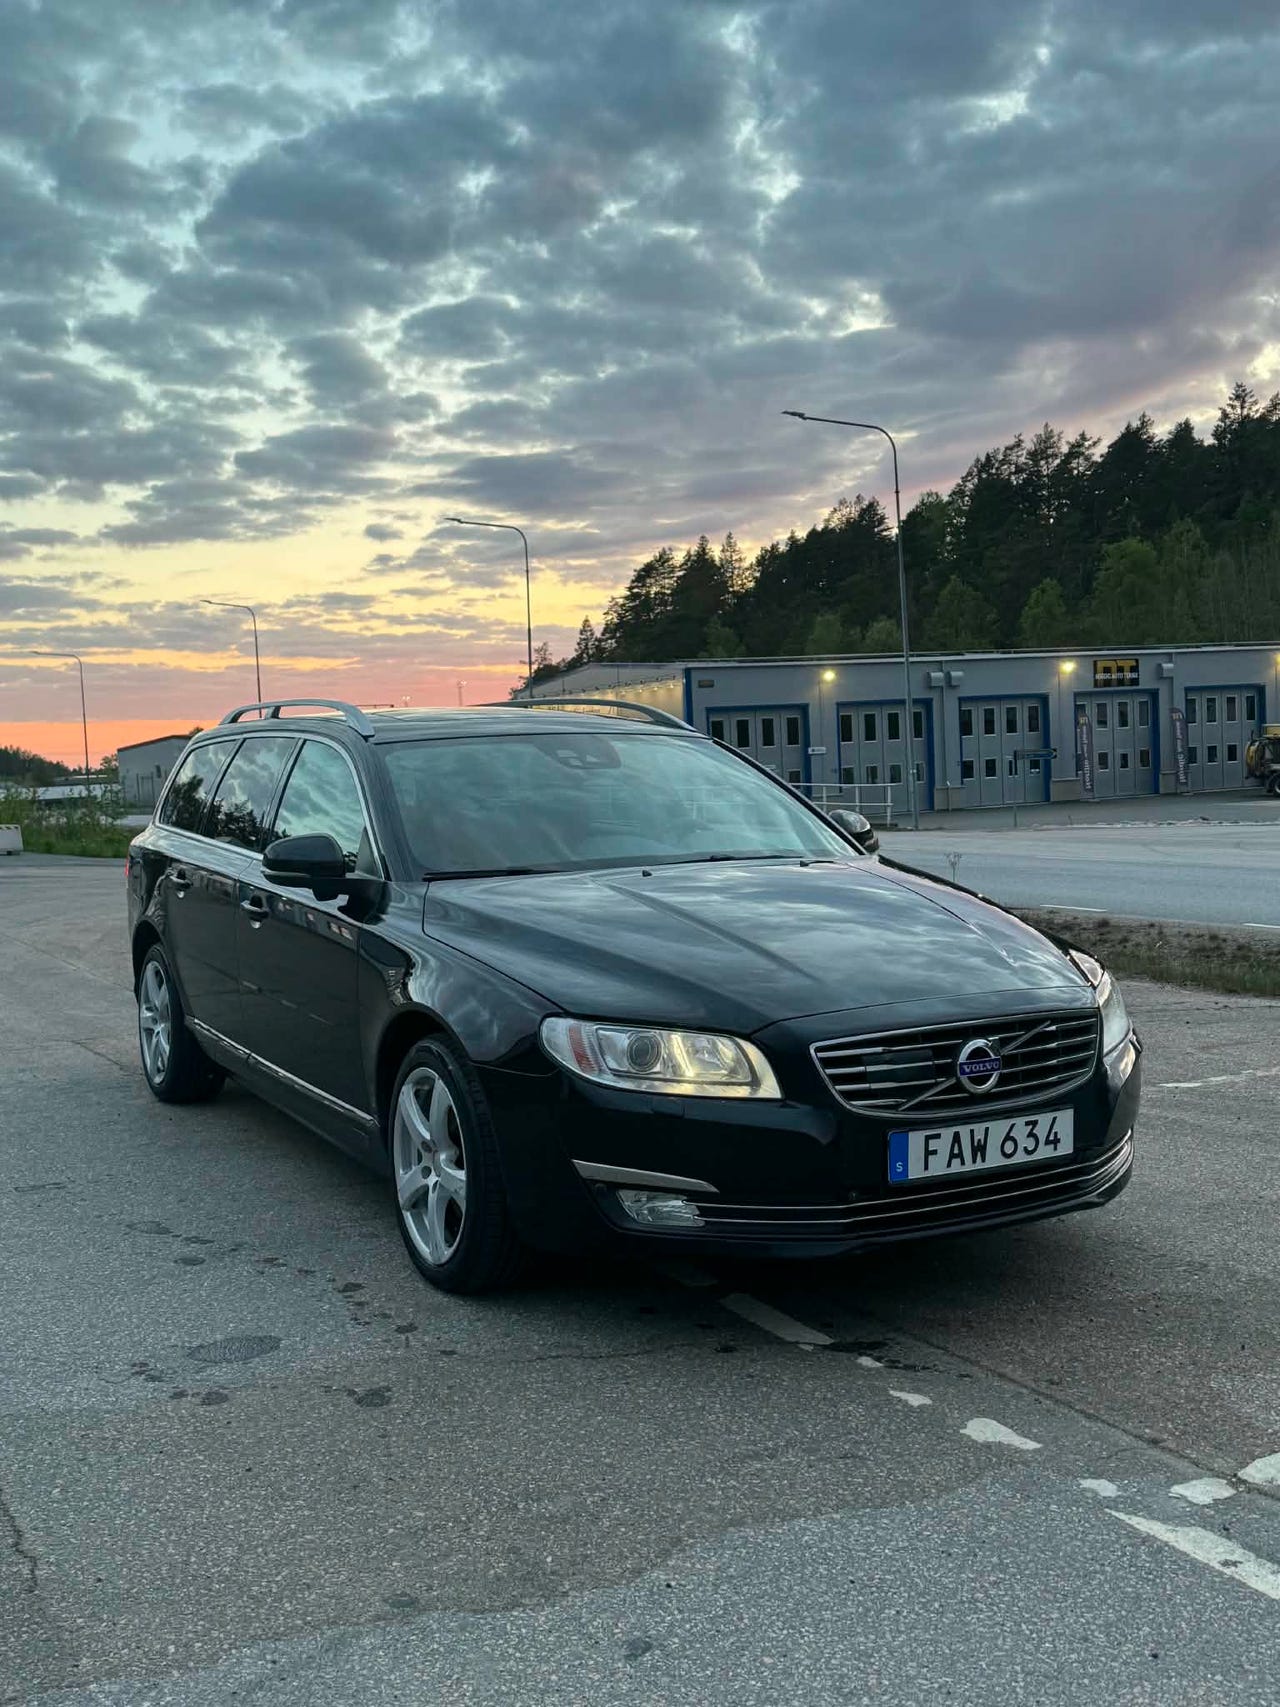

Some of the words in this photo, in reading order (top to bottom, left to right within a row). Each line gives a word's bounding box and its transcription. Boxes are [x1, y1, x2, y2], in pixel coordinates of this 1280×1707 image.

[962, 1060, 999, 1073] VOLVO
[896, 1162, 904, 1173] S
[924, 1126, 989, 1171] FAW
[1000, 1115, 1061, 1159] 634
